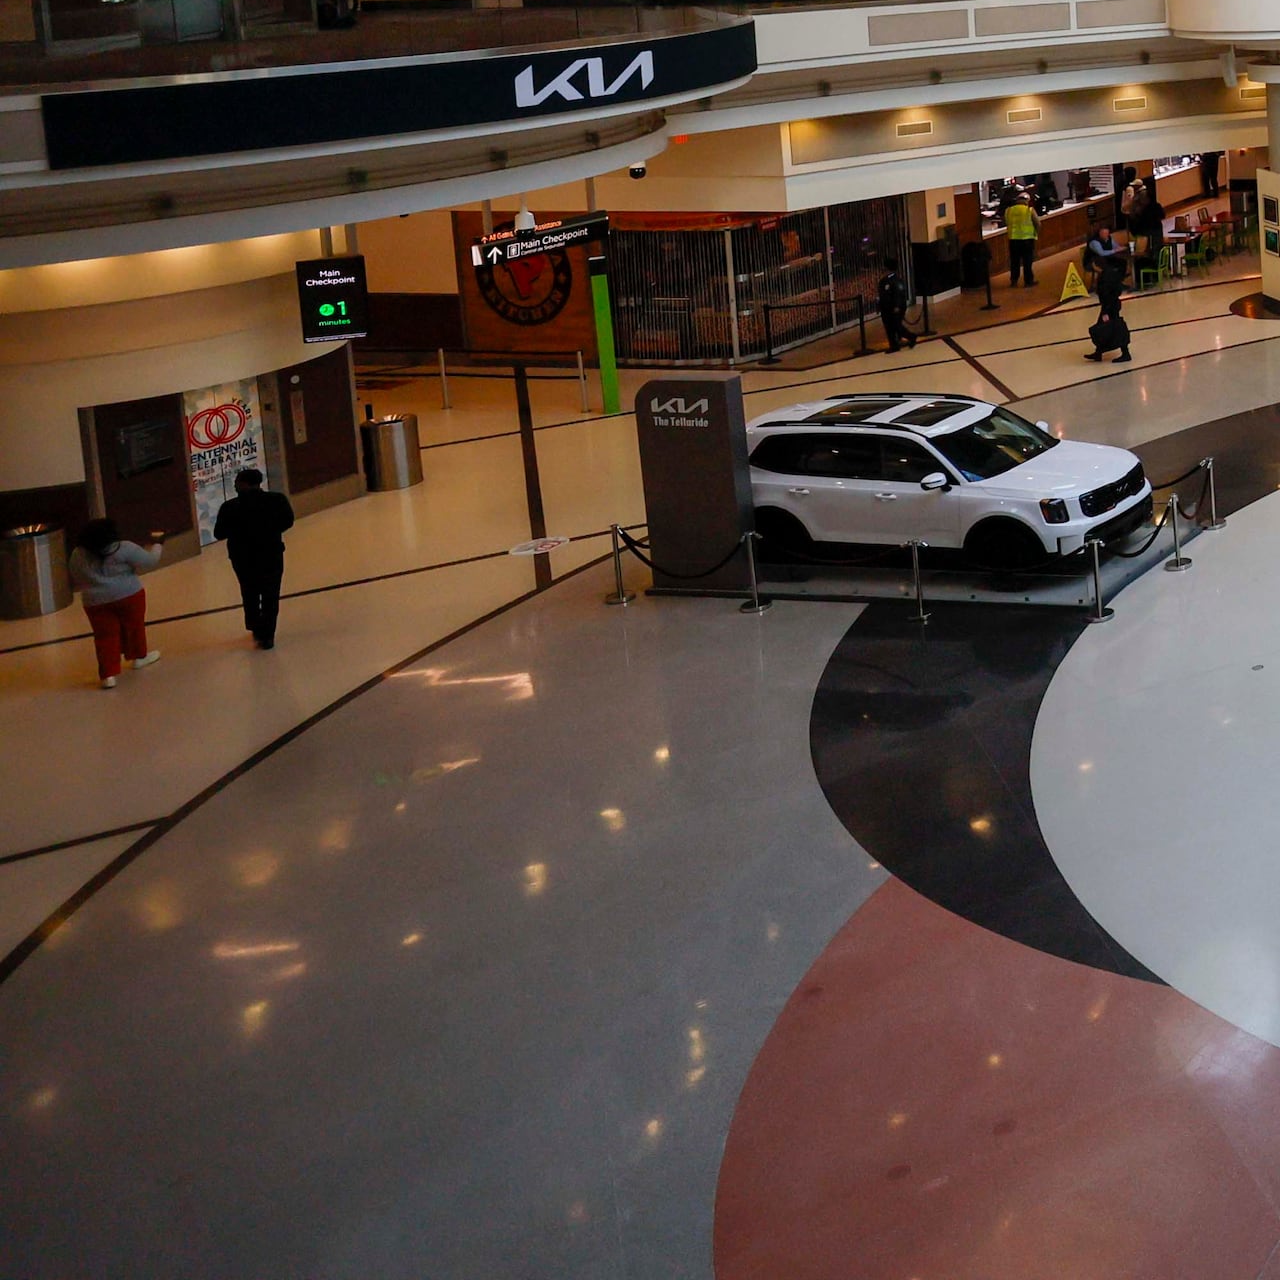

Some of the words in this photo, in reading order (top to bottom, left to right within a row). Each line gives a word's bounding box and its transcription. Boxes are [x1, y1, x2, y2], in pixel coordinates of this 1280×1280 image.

[515, 49, 655, 108] KIA
[520, 238, 541, 250] Main
[542, 227, 588, 245] Checkpoint
[305, 276, 356, 287] Checkpoint
[319, 269, 341, 278] Main
[337, 301, 347, 316] 1
[650, 396, 709, 414] KIA
[652, 416, 669, 427] The
[670, 416, 709, 428] Telluride
[190, 437, 257, 463] ENTENNIAL
